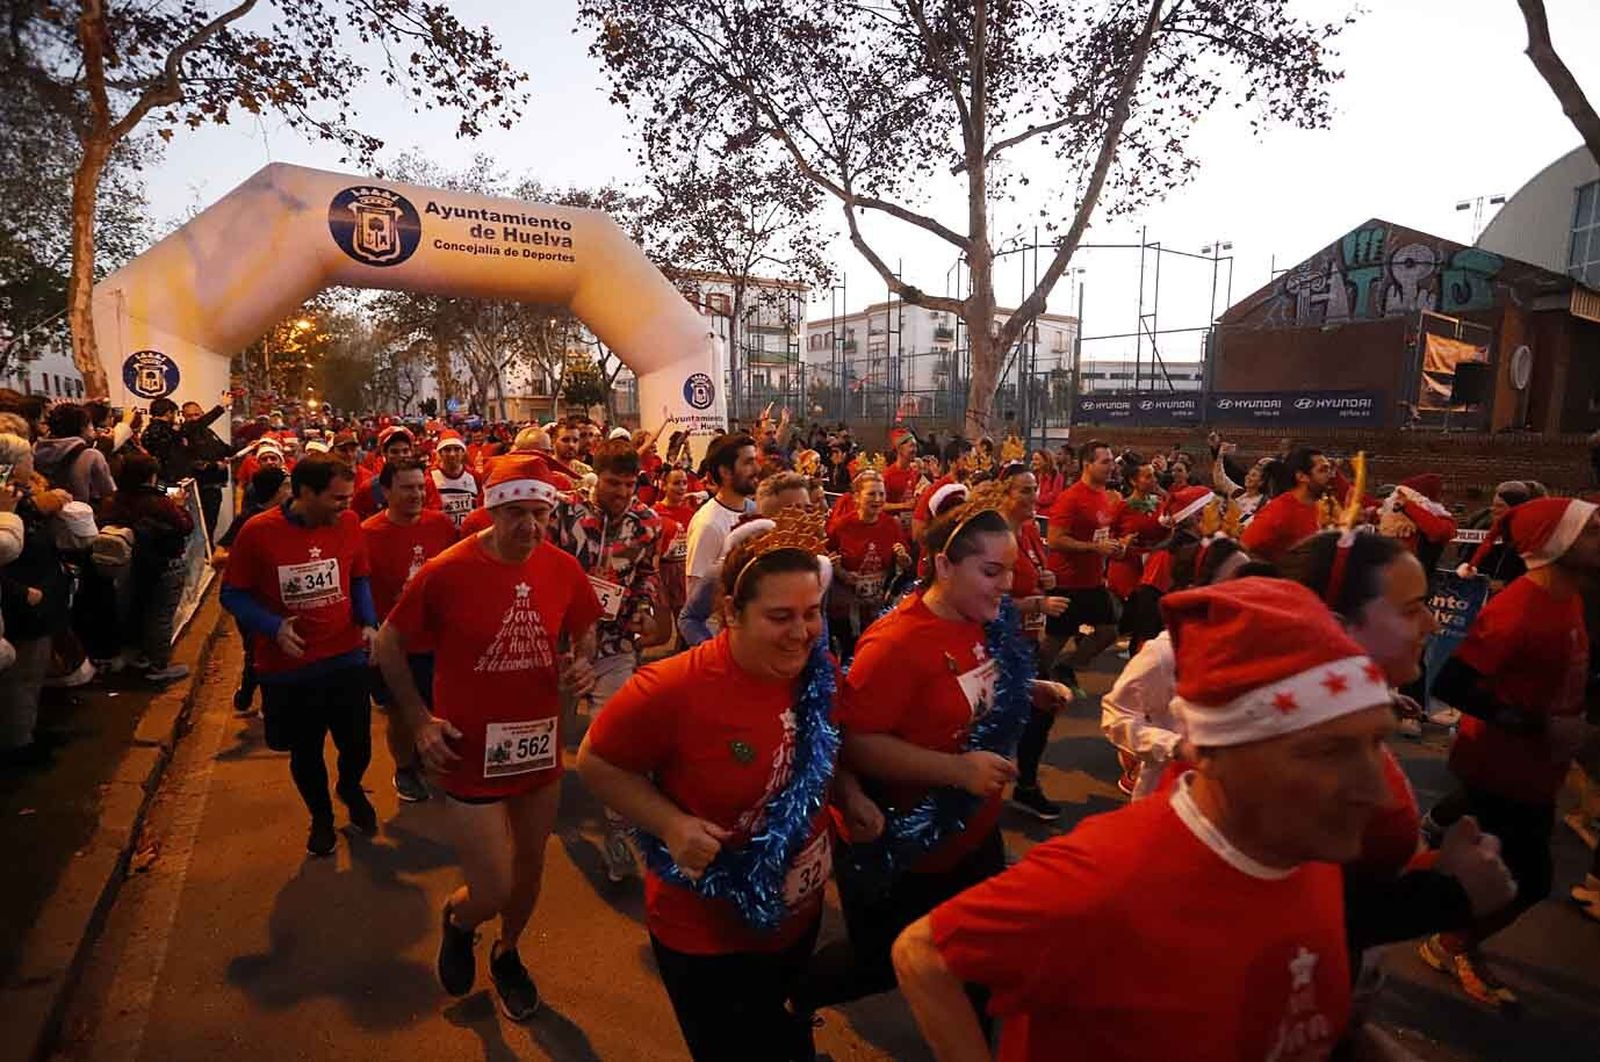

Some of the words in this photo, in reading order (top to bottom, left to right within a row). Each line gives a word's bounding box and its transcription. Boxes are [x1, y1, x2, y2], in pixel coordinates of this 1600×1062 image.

[425, 201, 572, 231] Ayuntamiento
[470, 224, 496, 239] de
[503, 227, 573, 248] Huelva
[504, 247, 519, 257] de
[522, 249, 575, 263] Deportes
[1155, 400, 1195, 409] HYUNDAI
[1234, 399, 1282, 409] HYUNDAI
[1317, 398, 1373, 409] HYUNDAI
[304, 571, 334, 590] 341
[601, 593, 610, 608] 5
[1429, 595, 1469, 611] nto
[502, 606, 541, 623] San
[517, 734, 550, 759] 562
